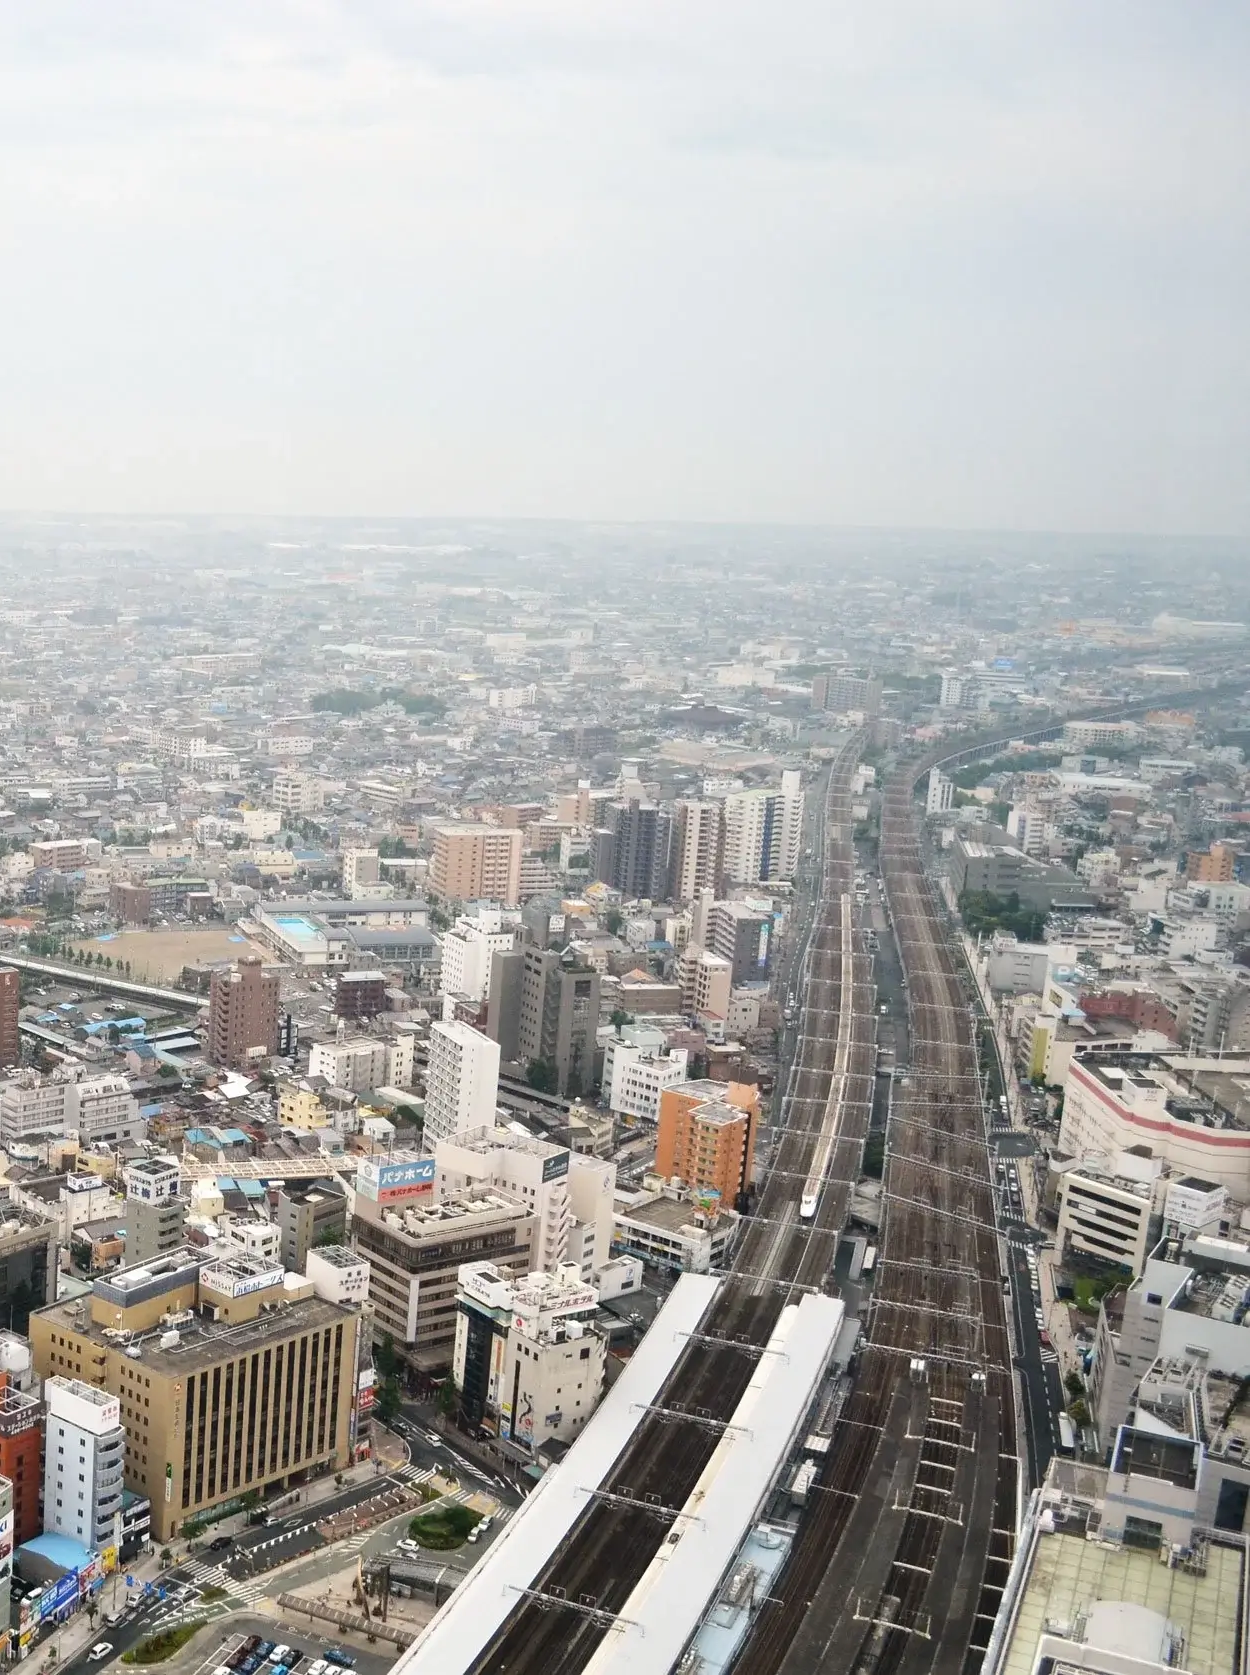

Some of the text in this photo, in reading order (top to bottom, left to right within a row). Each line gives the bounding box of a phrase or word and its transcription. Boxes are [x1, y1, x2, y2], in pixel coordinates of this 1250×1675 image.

[381, 1165, 432, 1185] パナホーム
